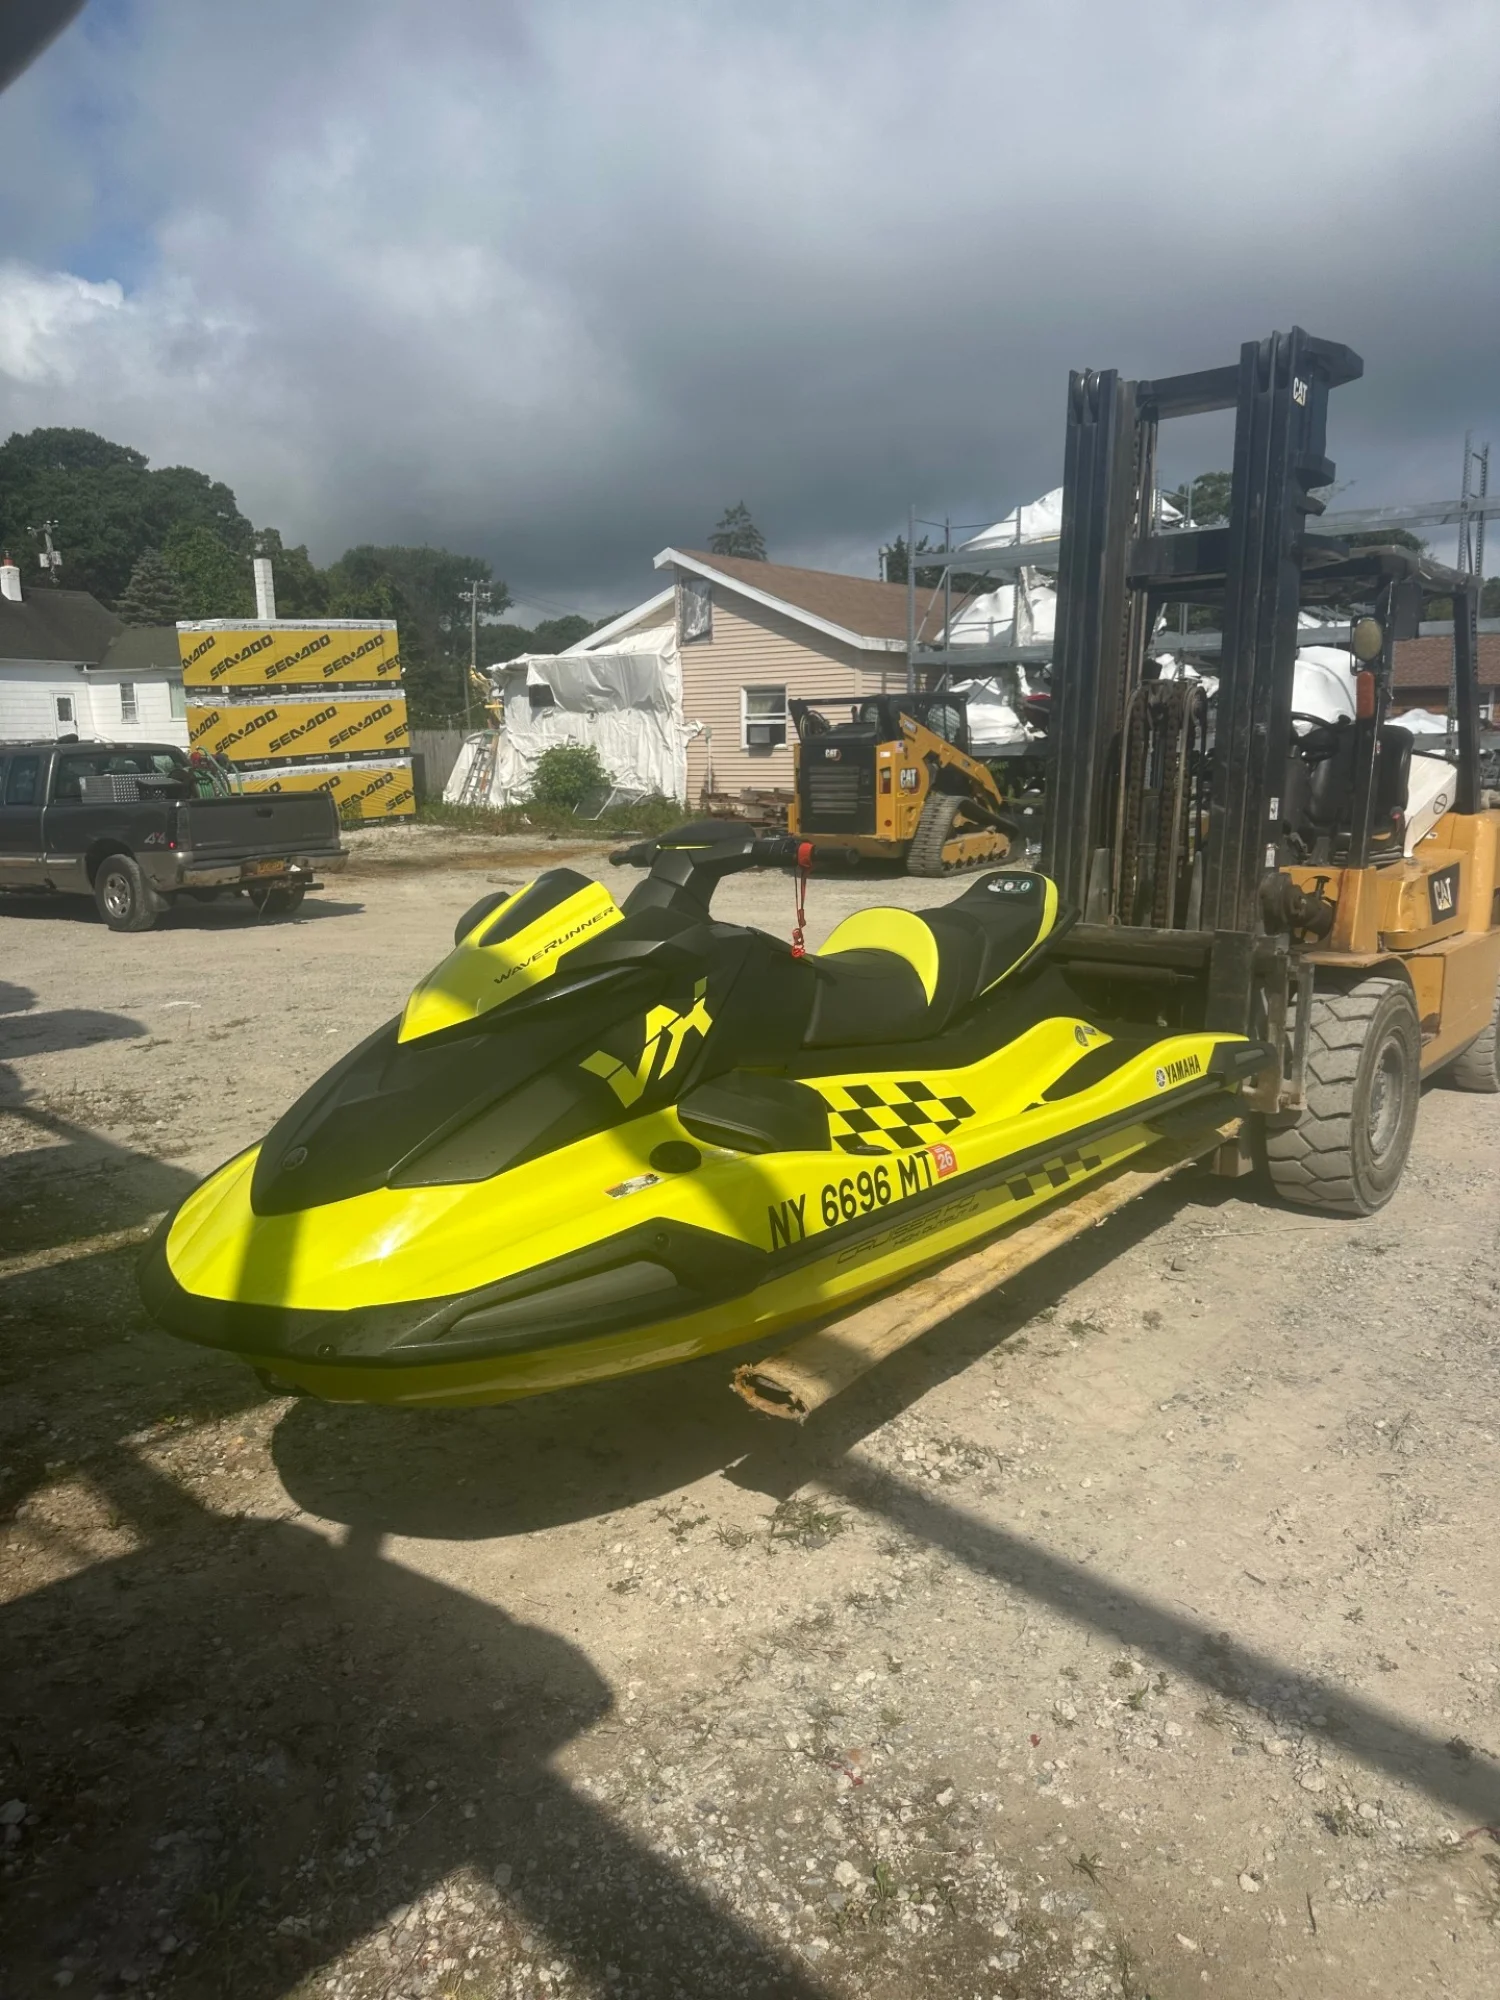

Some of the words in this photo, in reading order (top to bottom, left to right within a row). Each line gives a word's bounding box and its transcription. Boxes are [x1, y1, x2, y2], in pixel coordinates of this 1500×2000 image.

[1293, 377, 1308, 406] CAT
[825, 748, 838, 758] CAT
[901, 769, 917, 788] CAT
[1434, 878, 1452, 911] CAT
[1164, 1054, 1201, 1084] YAMAHA
[938, 1151, 953, 1170] 26
[768, 1194, 806, 1250] NY
[821, 1165, 891, 1227] 6696
[897, 1151, 933, 1198] MT
[837, 1208, 942, 1265] CRUISER
